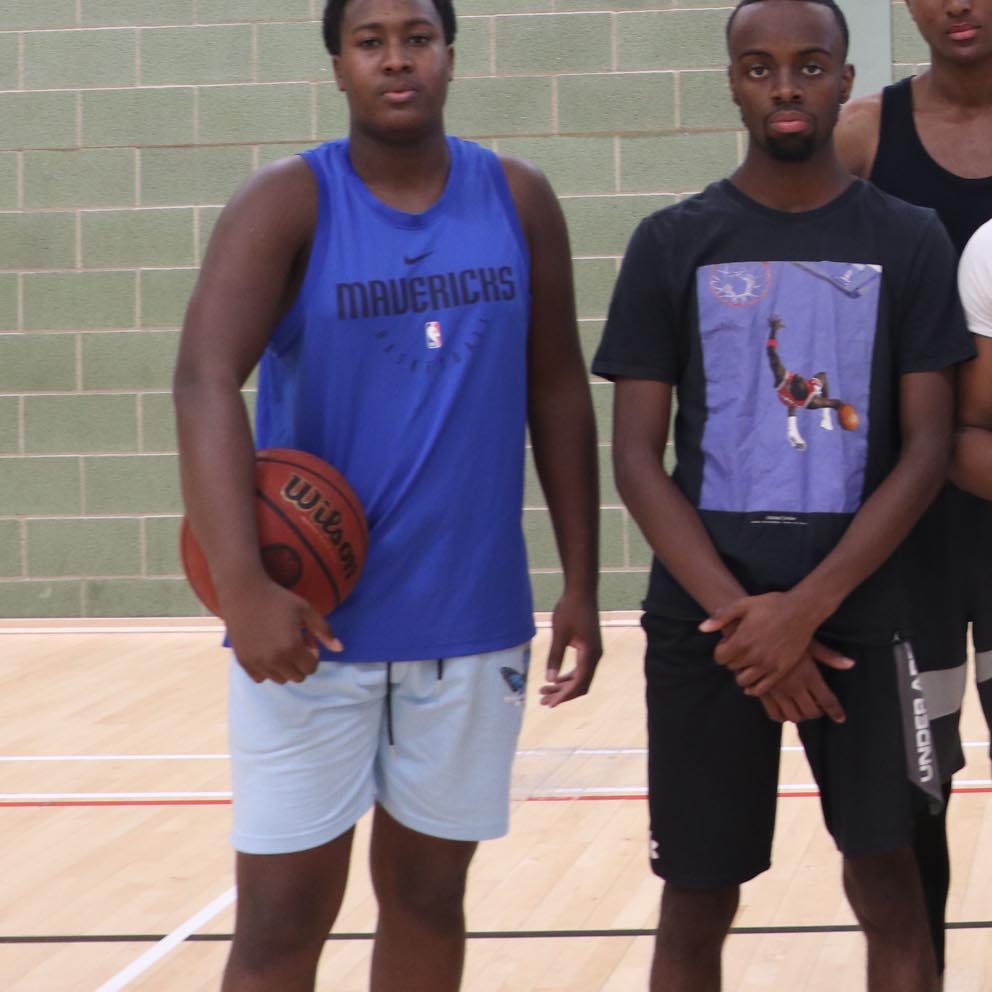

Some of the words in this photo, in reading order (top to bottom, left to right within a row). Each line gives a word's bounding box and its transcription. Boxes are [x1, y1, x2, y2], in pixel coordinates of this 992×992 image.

[335, 265, 516, 321] MAVERICKS
[281, 474, 357, 579] Wilson
[912, 697, 934, 783] UNDER
